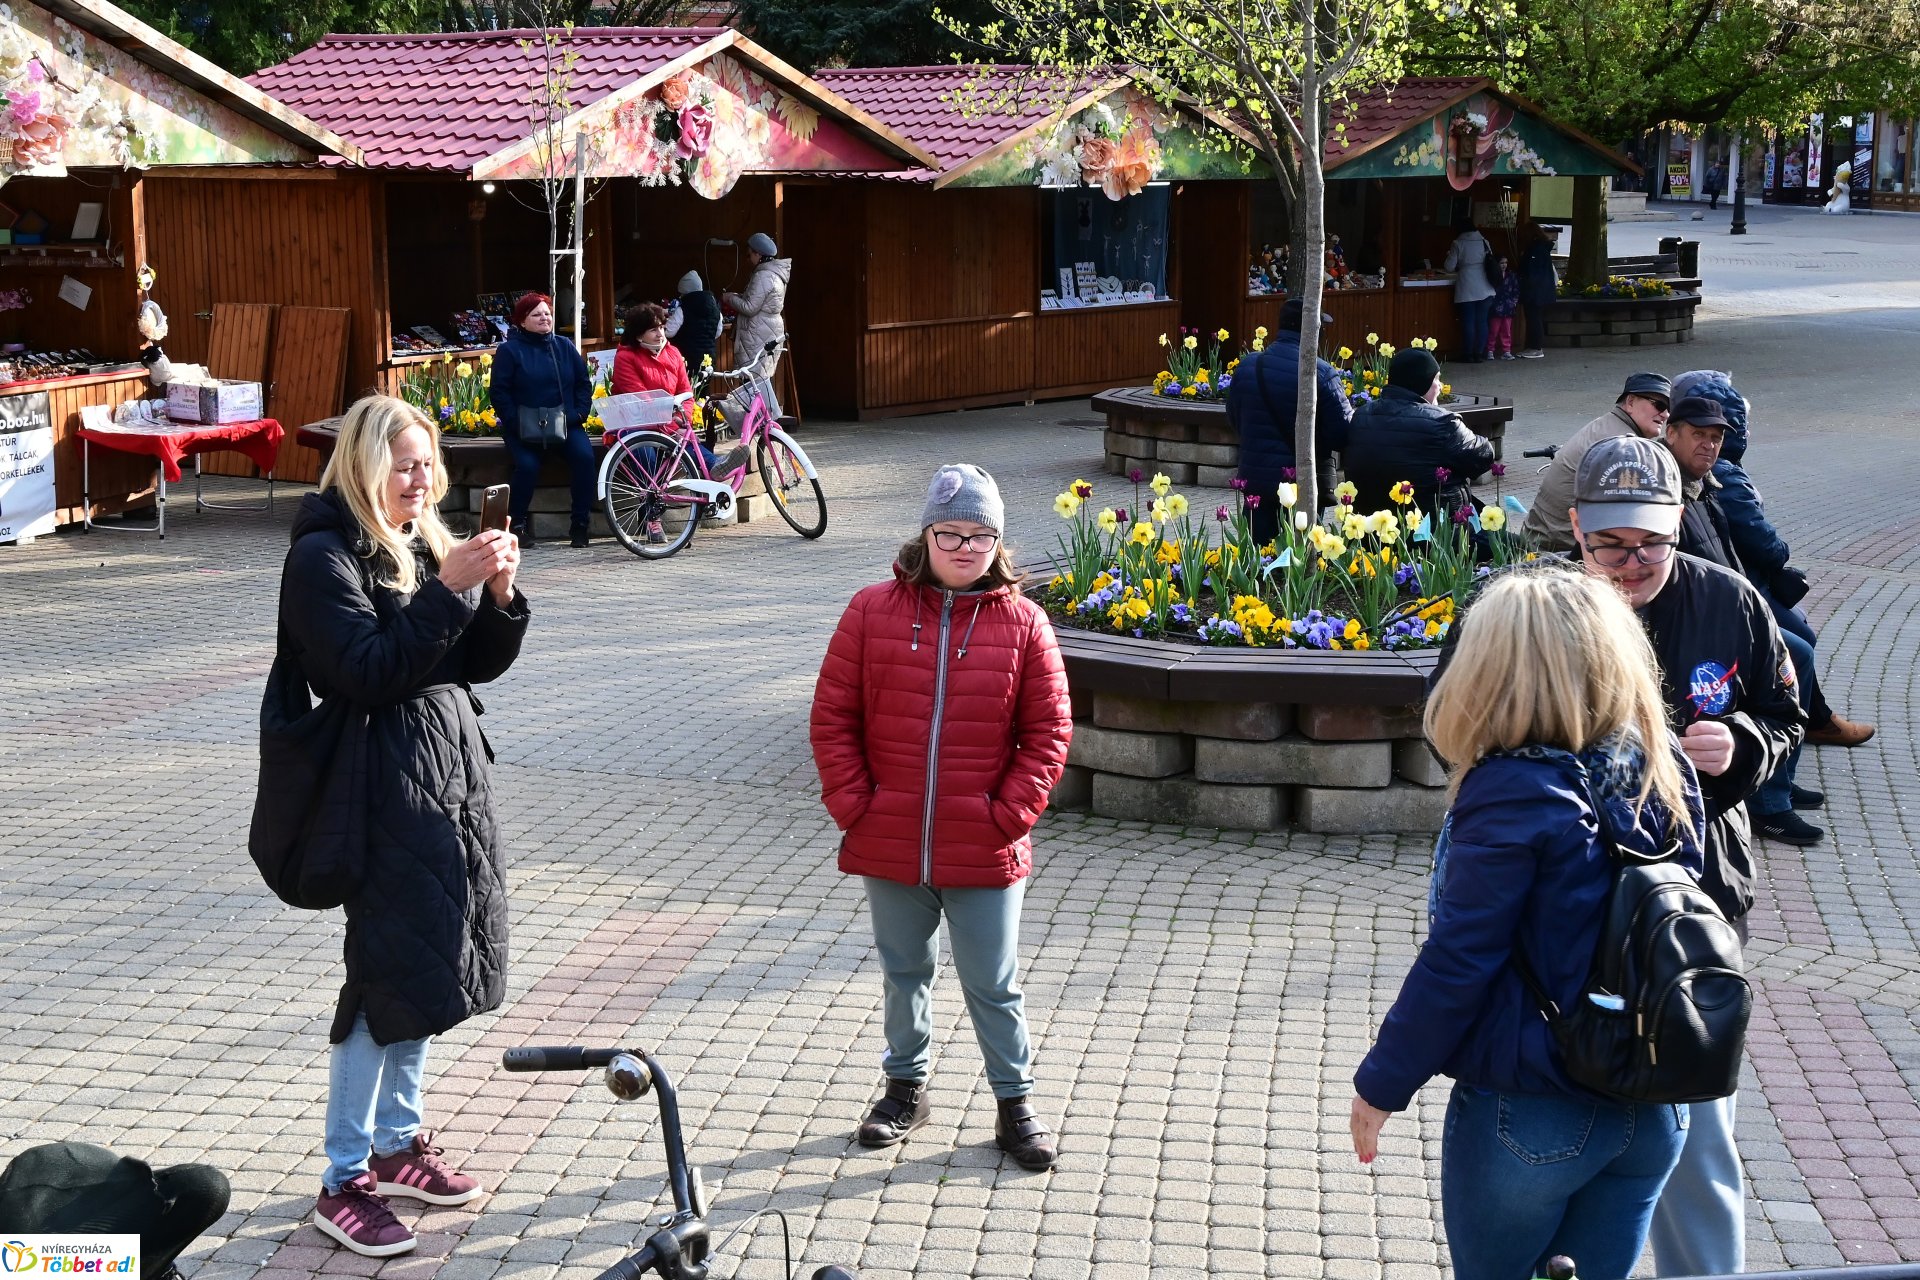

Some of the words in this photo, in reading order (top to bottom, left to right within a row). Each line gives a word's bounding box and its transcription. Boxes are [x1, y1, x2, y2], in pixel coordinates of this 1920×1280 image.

[1669, 175, 1689, 185] 50%
[0, 436, 17, 448] TÚR
[1599, 461, 1623, 487] COLUMBIA
[1624, 461, 1659, 488] SPORTSWEAR
[0, 527, 11, 537] OZ
[1691, 681, 1730, 695] NASA
